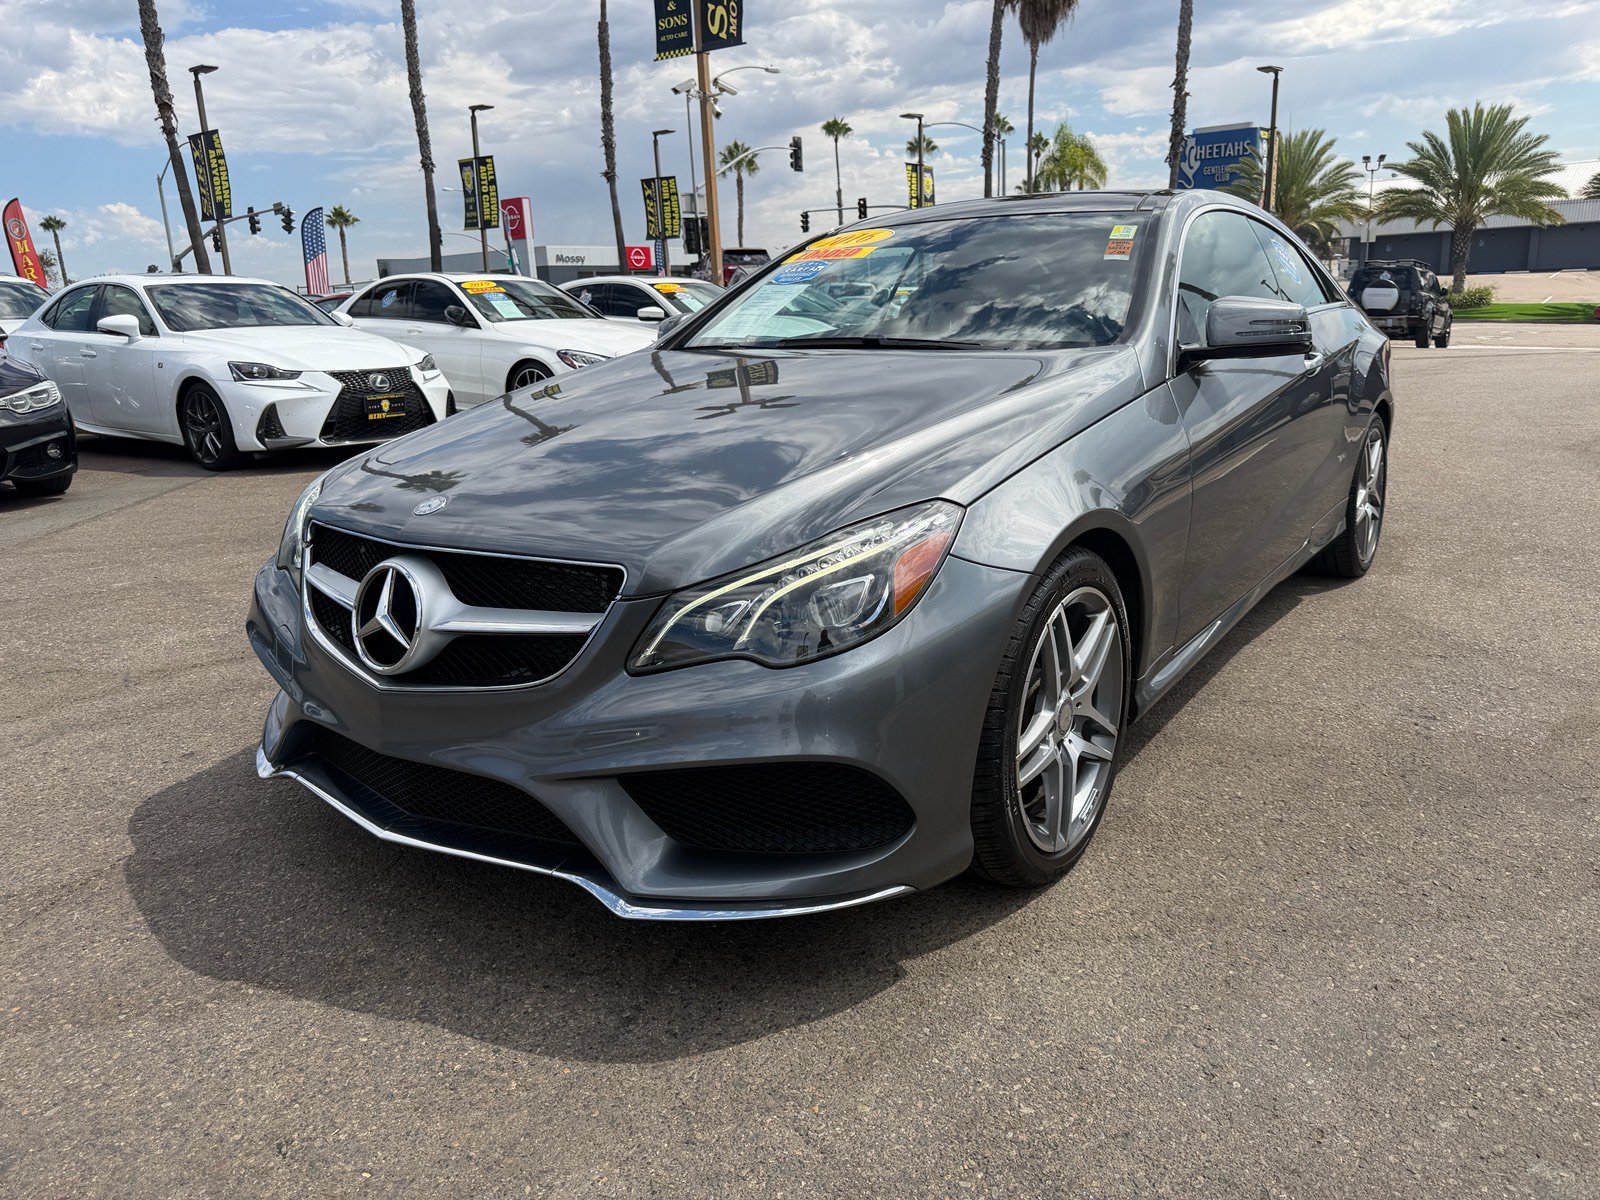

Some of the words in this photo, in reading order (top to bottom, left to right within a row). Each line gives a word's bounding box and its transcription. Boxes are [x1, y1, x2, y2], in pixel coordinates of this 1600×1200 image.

[667, 1, 676, 11] &
[658, 13, 688, 31] SONS
[660, 33, 674, 41] AUTO
[674, 30, 688, 39] CARE
[208, 149, 223, 203] ANYONE
[212, 133, 223, 157] WE
[218, 158, 231, 216] FINANCE
[479, 165, 489, 193] AUTO
[485, 158, 495, 181] FULL
[1215, 173, 1230, 182] CLUB
[661, 179, 670, 199] OUR
[668, 178, 677, 194] WE
[482, 194, 491, 221] CARE
[489, 185, 498, 227] SERVICE
[643, 181, 656, 237] SIRY
[663, 200, 672, 237] TROOPS
[670, 194, 680, 236] SUPPORT
[15, 239, 39, 280] MAR
[555, 253, 586, 264] Mossy
[794, 247, 864, 261] LOADED
